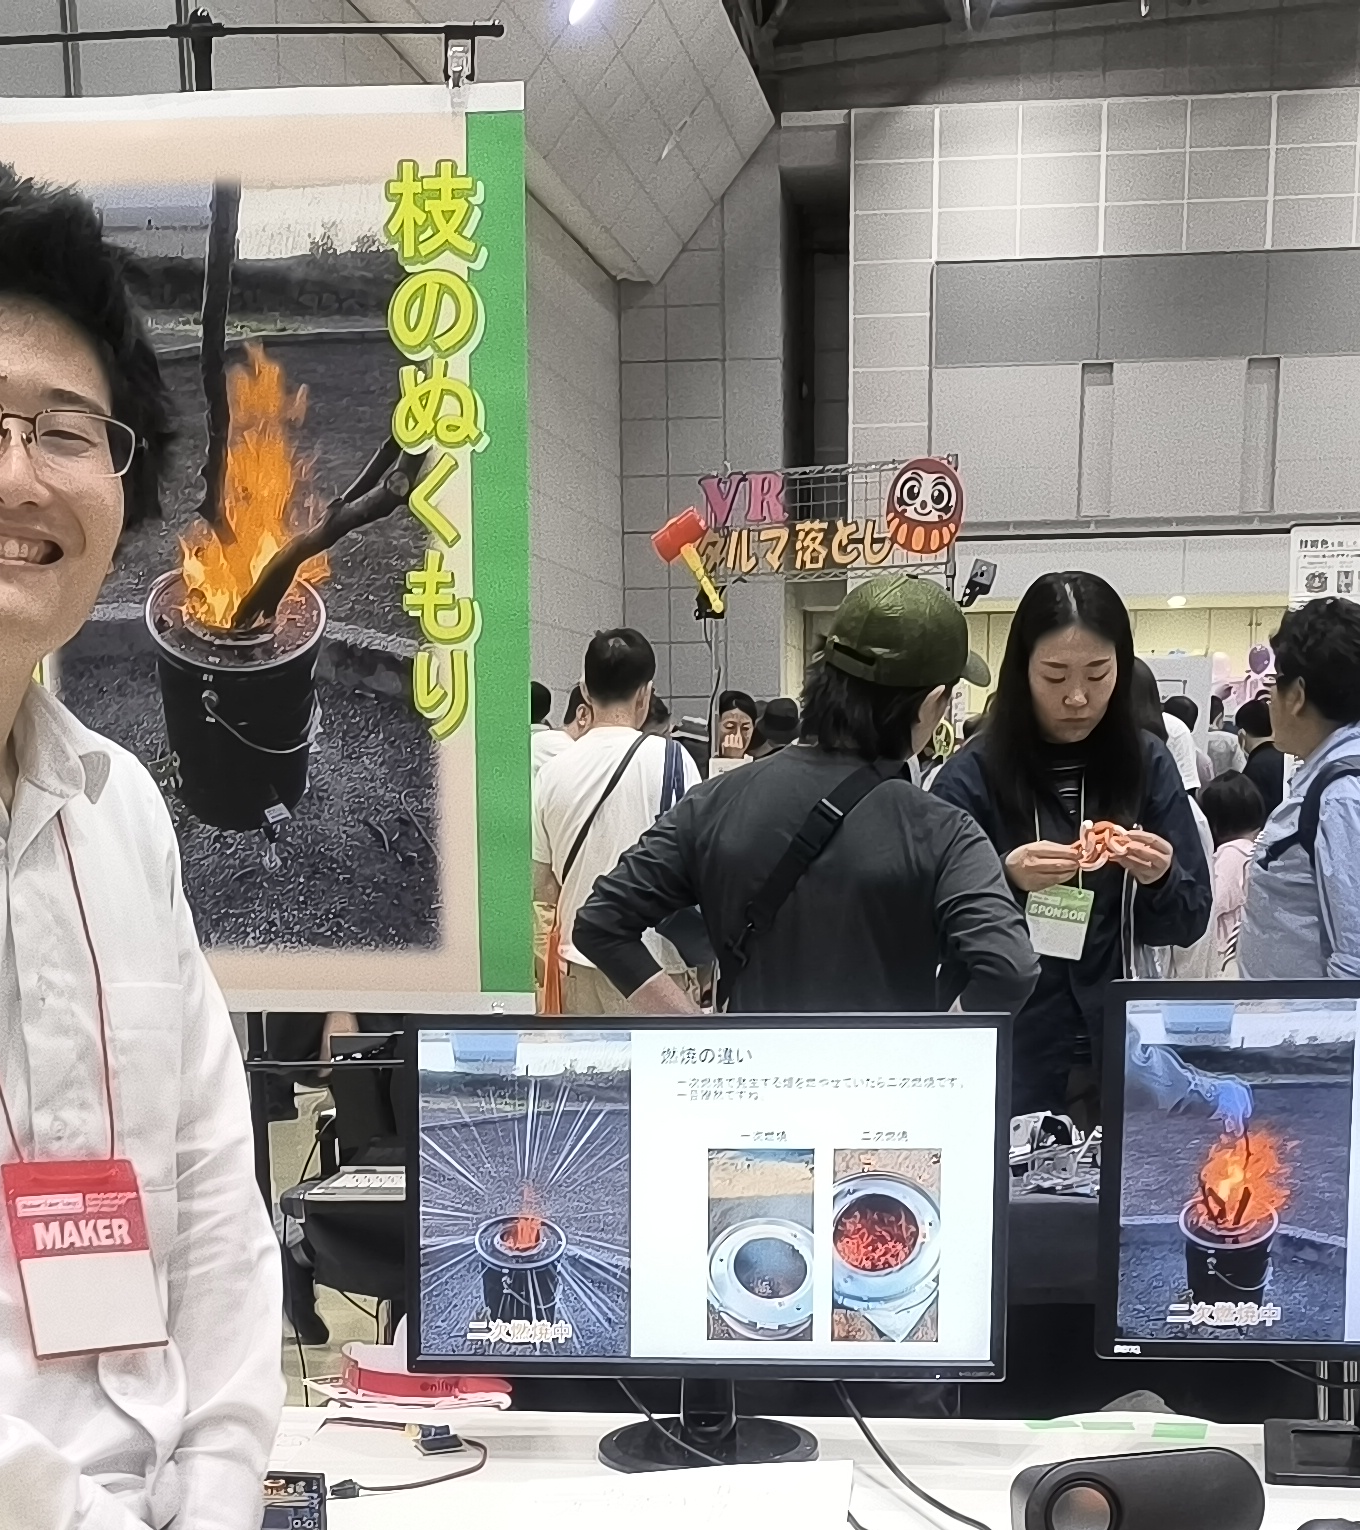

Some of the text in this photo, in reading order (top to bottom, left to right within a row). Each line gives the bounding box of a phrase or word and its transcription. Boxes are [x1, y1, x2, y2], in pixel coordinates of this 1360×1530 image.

[385, 160, 482, 741] 枝のぬくもり
[699, 472, 788, 527] VR
[1028, 903, 1087, 922] SPONSOR
[660, 1046, 753, 1066] 燃焼の違い
[32, 1217, 133, 1251] MAKER
[1165, 1301, 1283, 1327] 二次燃焼中
[466, 1319, 573, 1344] 二次燃焼中
